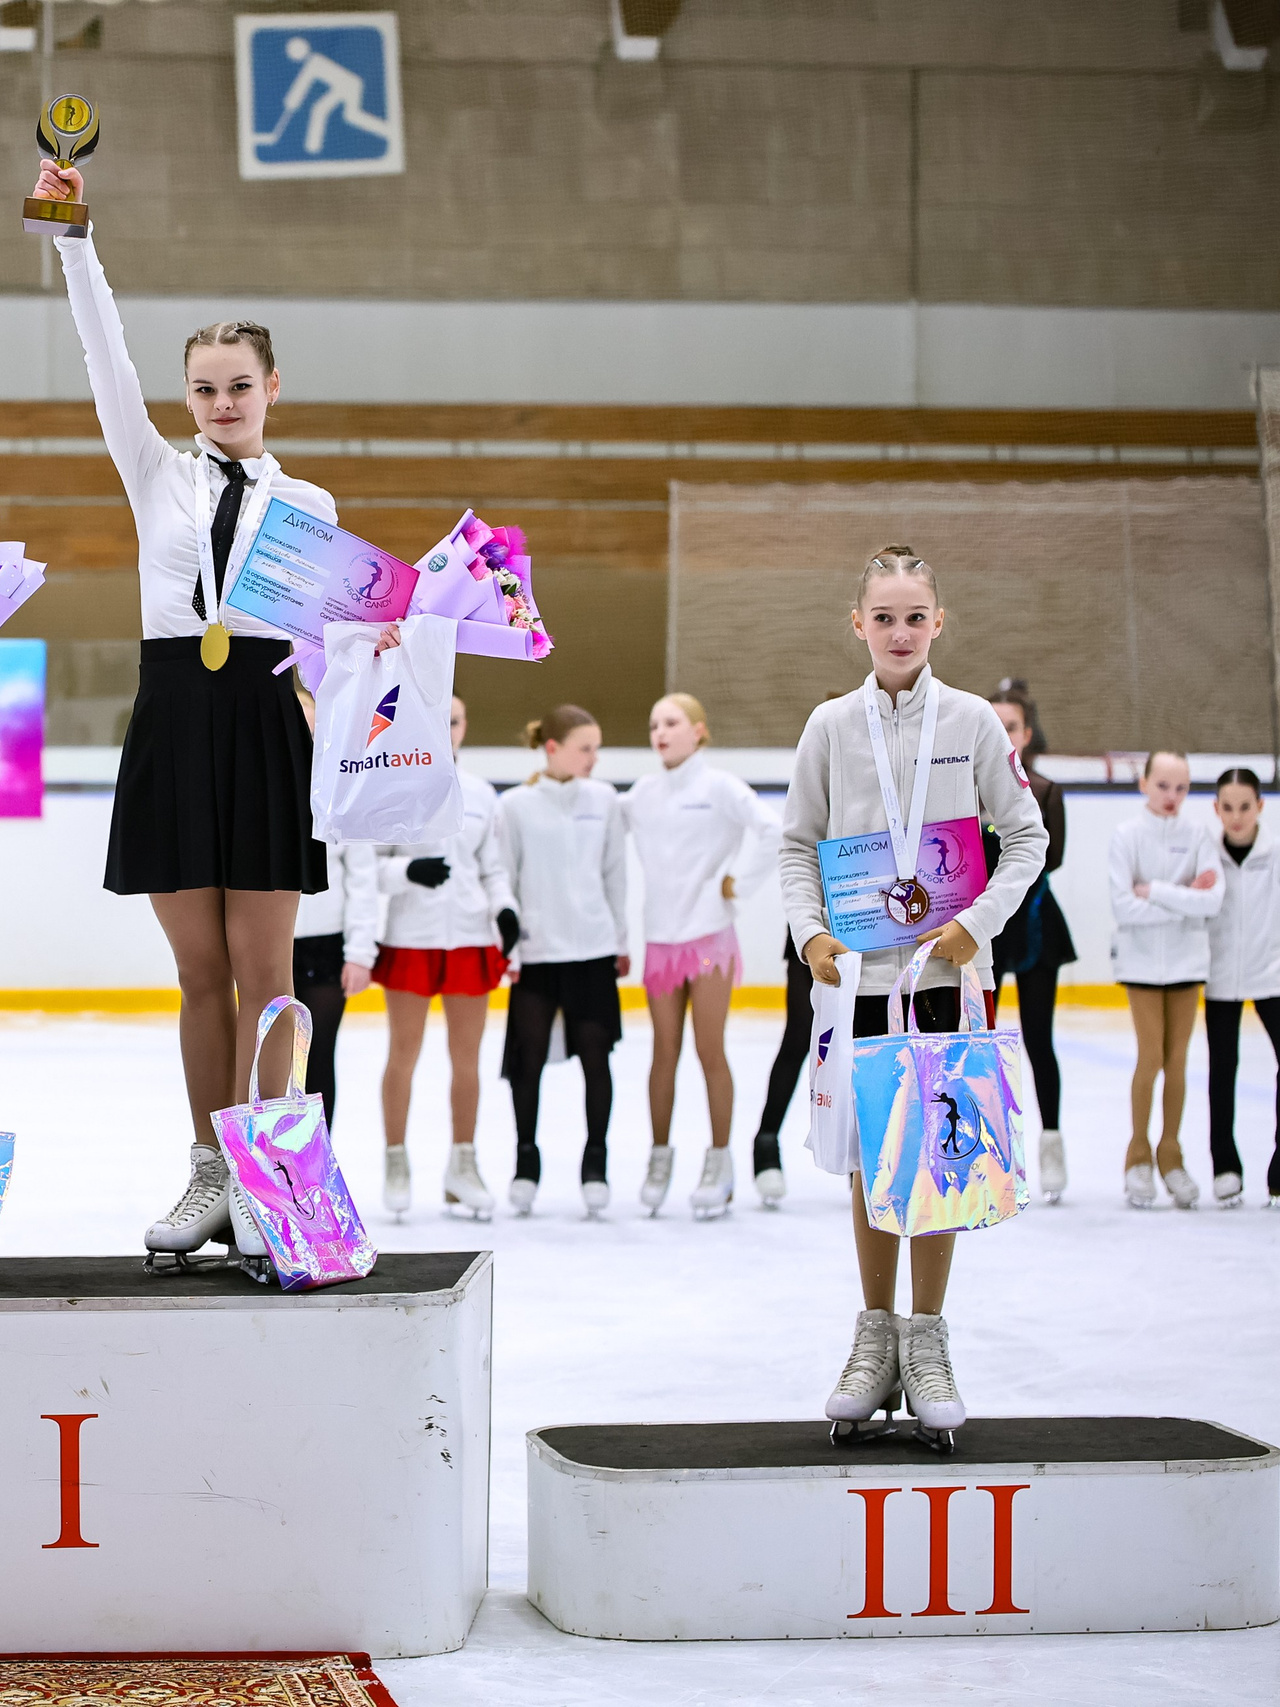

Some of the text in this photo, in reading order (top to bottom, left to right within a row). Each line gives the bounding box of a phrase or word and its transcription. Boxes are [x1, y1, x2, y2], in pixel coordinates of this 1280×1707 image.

[364, 597, 392, 609] CANDY
[339, 748, 432, 774] smartavia
[917, 861, 970, 884] КУБОК CANDY
[40, 1413, 99, 1549] I
[847, 1484, 1031, 1619] III
